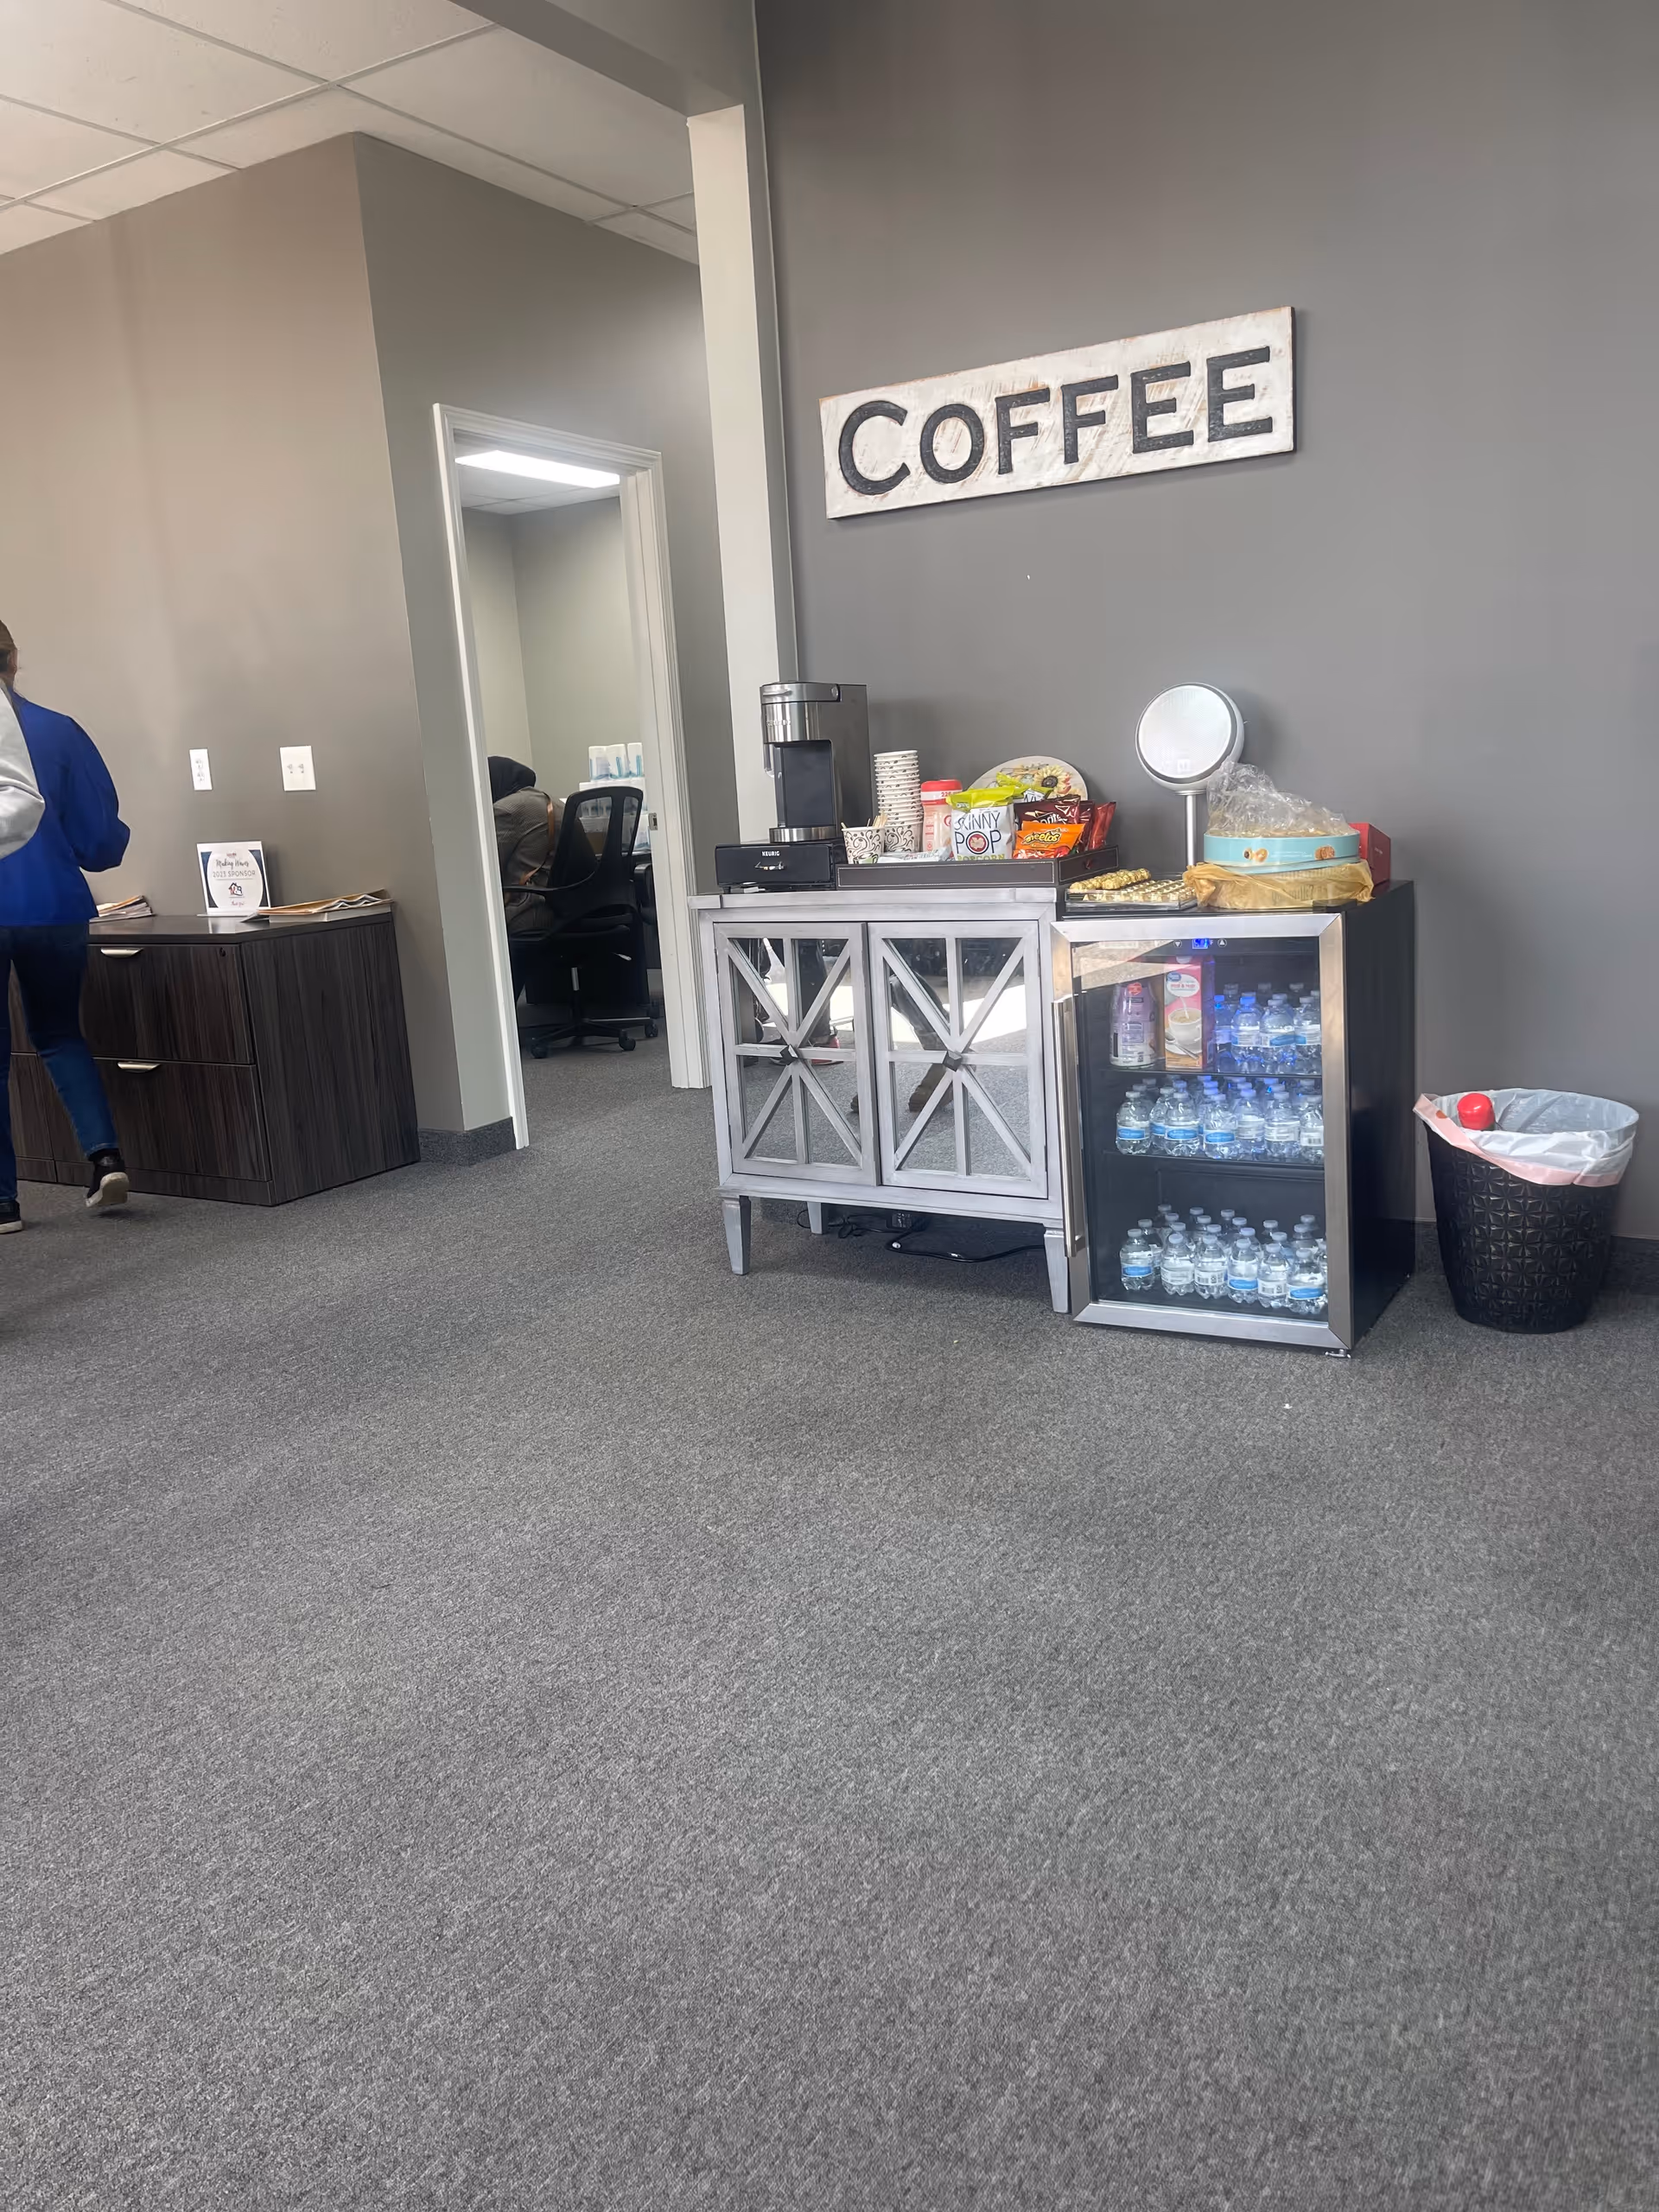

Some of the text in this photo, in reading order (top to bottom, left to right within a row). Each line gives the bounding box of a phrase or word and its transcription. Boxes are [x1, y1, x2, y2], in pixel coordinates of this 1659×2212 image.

[838, 346, 1274, 496] COFFEE
[954, 812, 1001, 830] SKINNY
[954, 830, 1001, 855] POP
